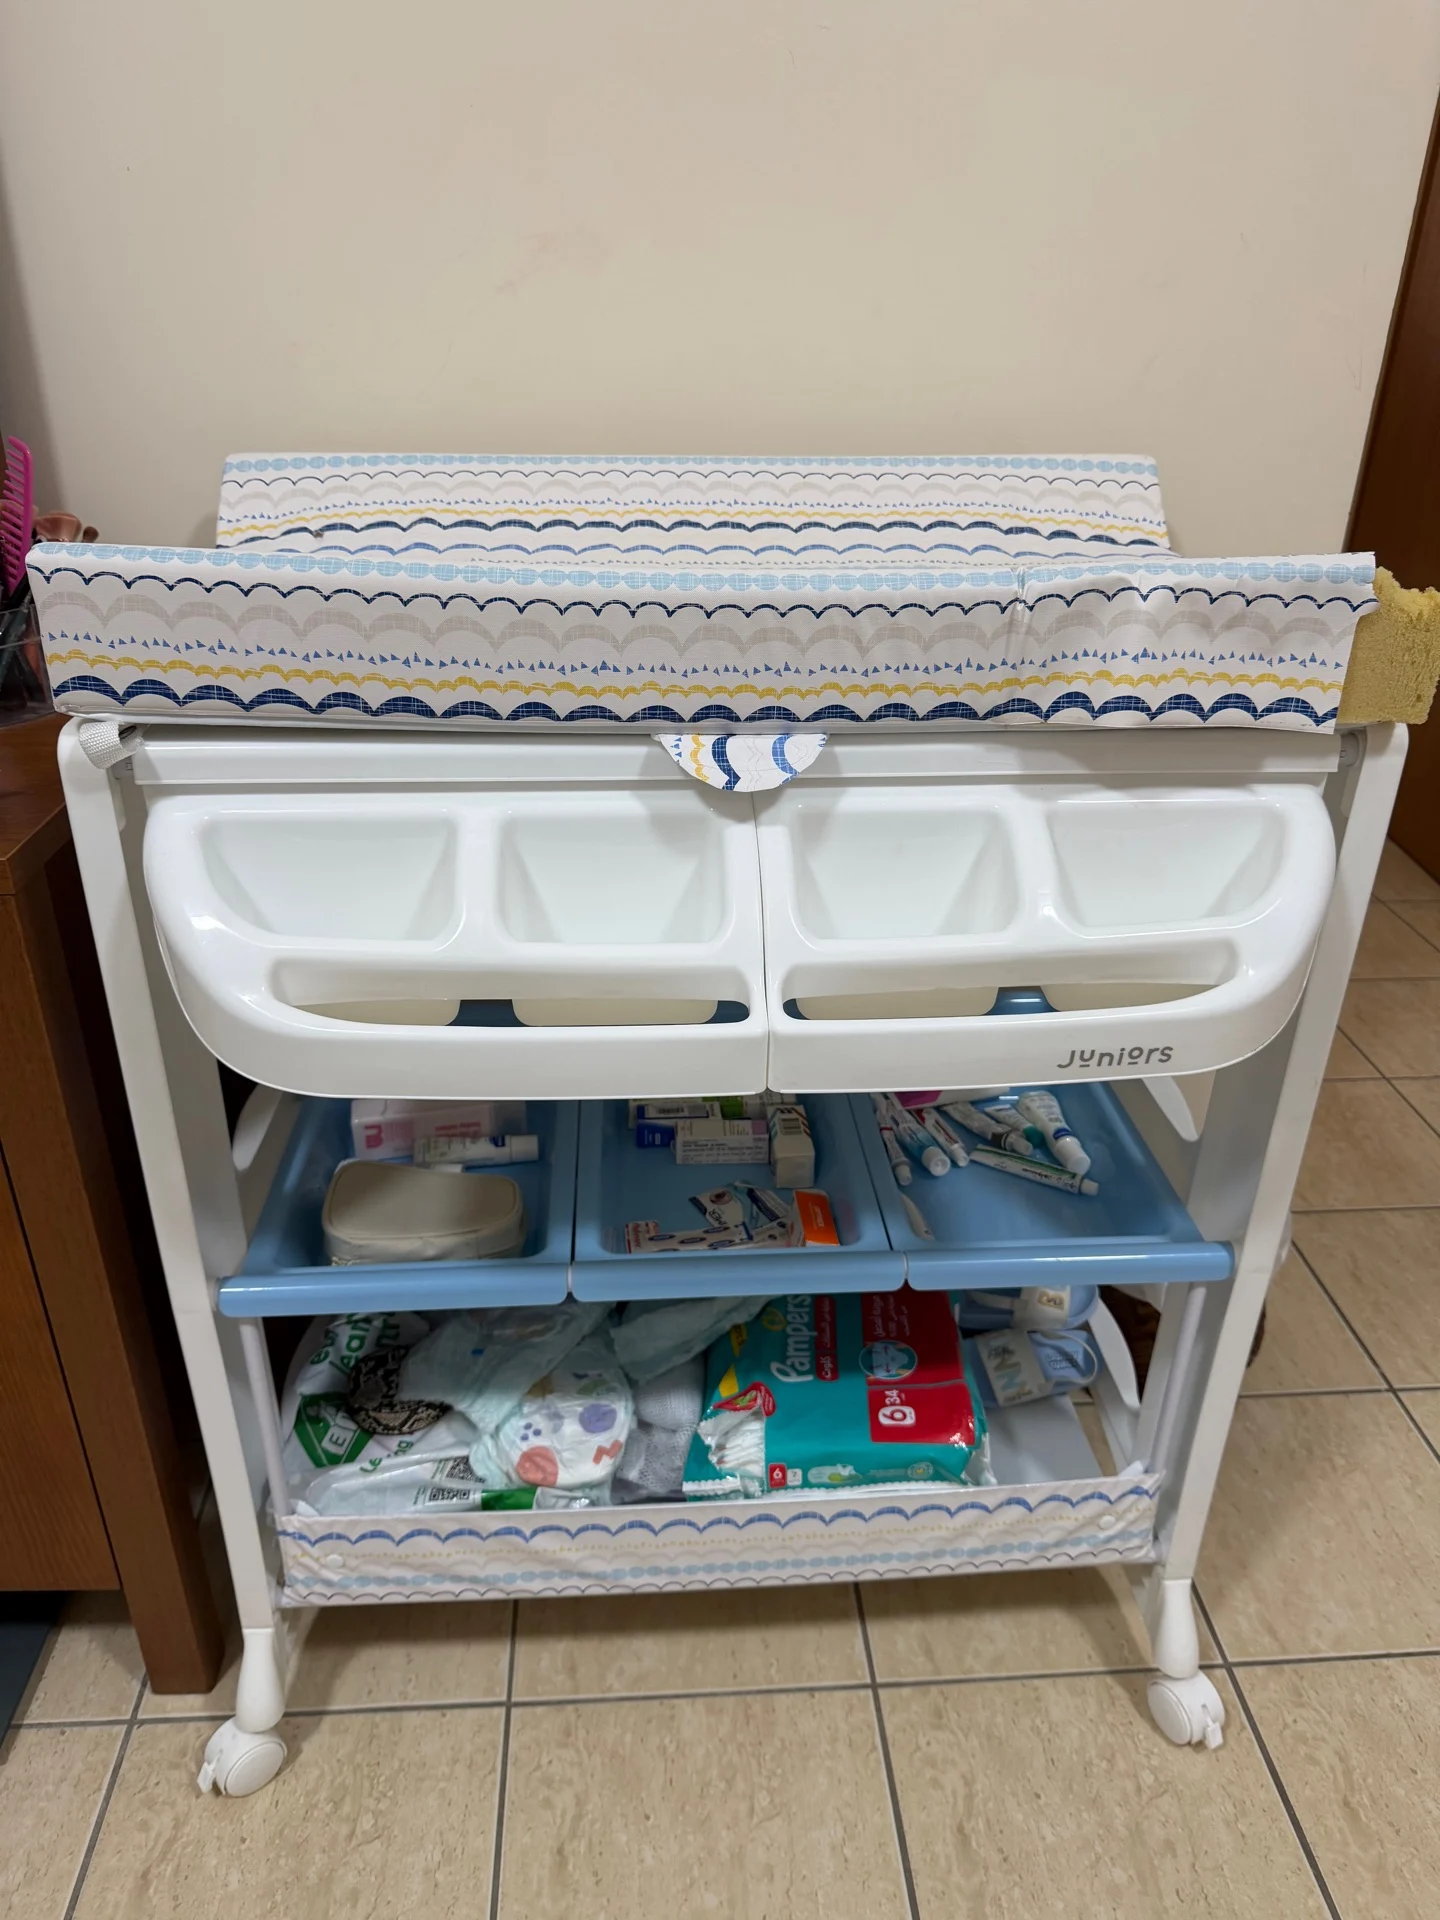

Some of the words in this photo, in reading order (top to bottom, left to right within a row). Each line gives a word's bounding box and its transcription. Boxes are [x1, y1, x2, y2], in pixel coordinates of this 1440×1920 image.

[1056, 1046, 1174, 1069] Juniors
[770, 1295, 818, 1383] Pampers
[884, 1389, 901, 1406] 34
[881, 1408, 907, 1422] 6
[772, 1467, 783, 1480] 6
